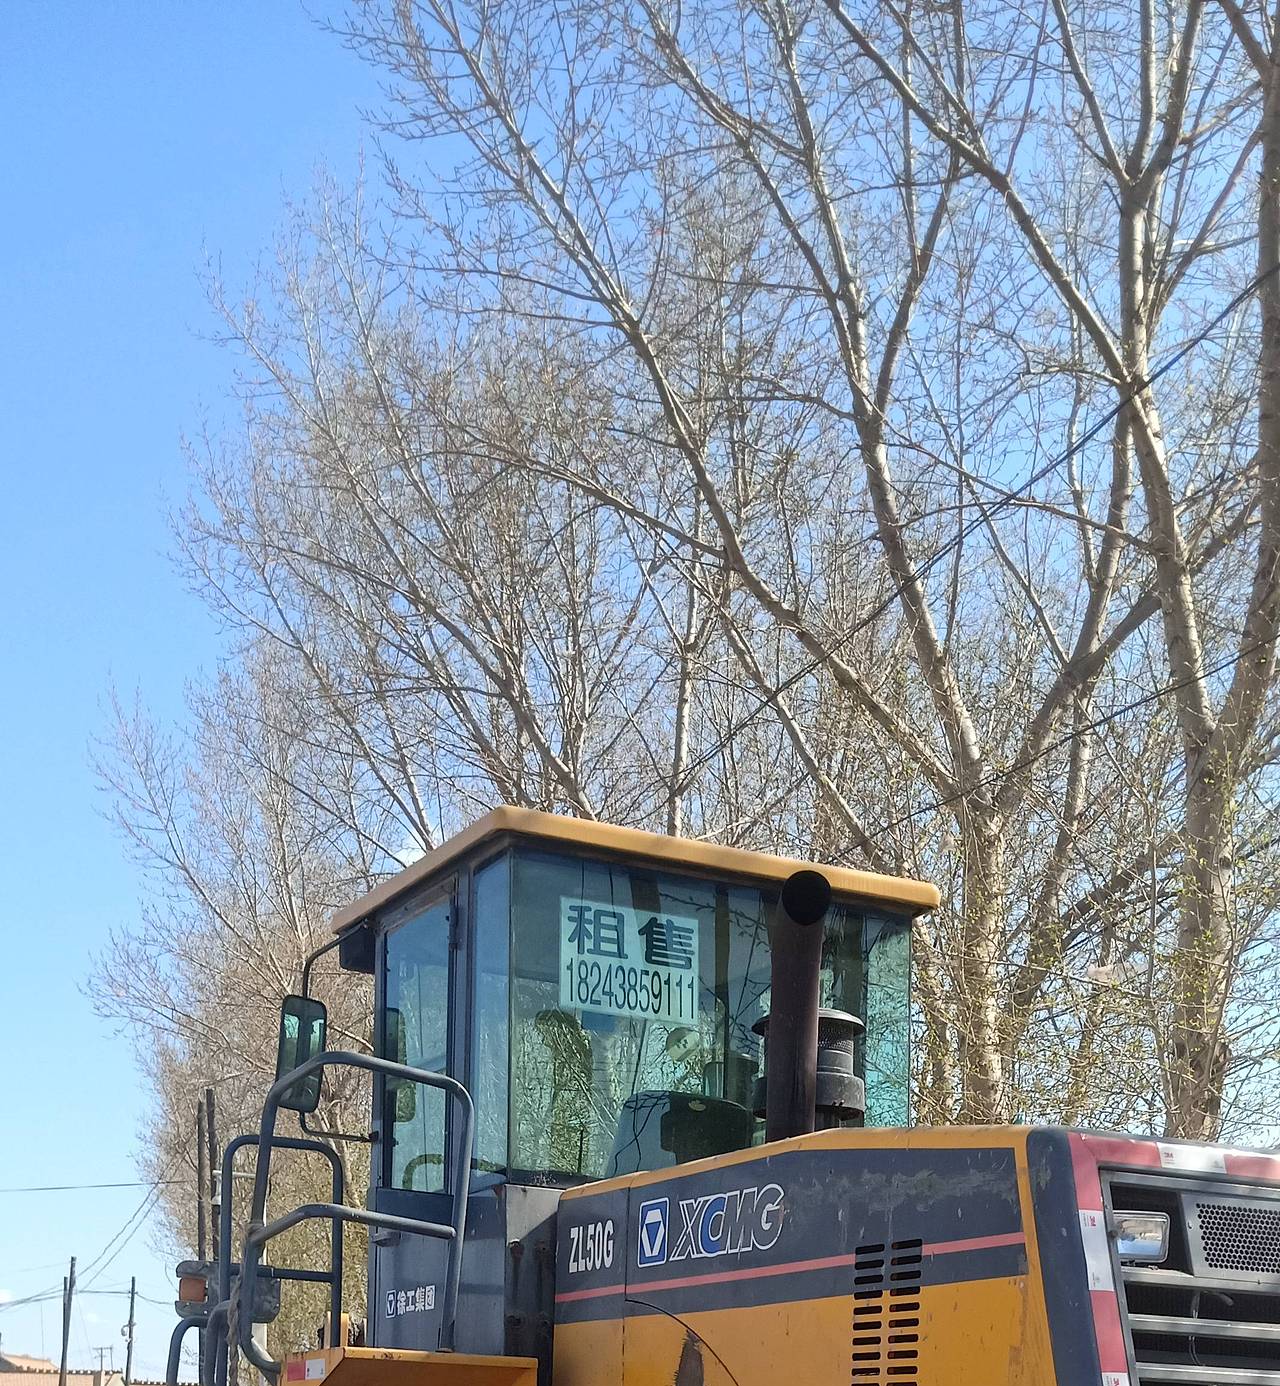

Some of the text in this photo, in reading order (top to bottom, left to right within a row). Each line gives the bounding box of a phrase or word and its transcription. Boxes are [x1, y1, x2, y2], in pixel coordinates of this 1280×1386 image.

[567, 905, 695, 970] 租售
[566, 957, 695, 1020] 18243859111
[568, 1219, 615, 1274] ZL50G
[669, 1183, 785, 1262] XCMG
[397, 1285, 436, 1316] 徐工集团
